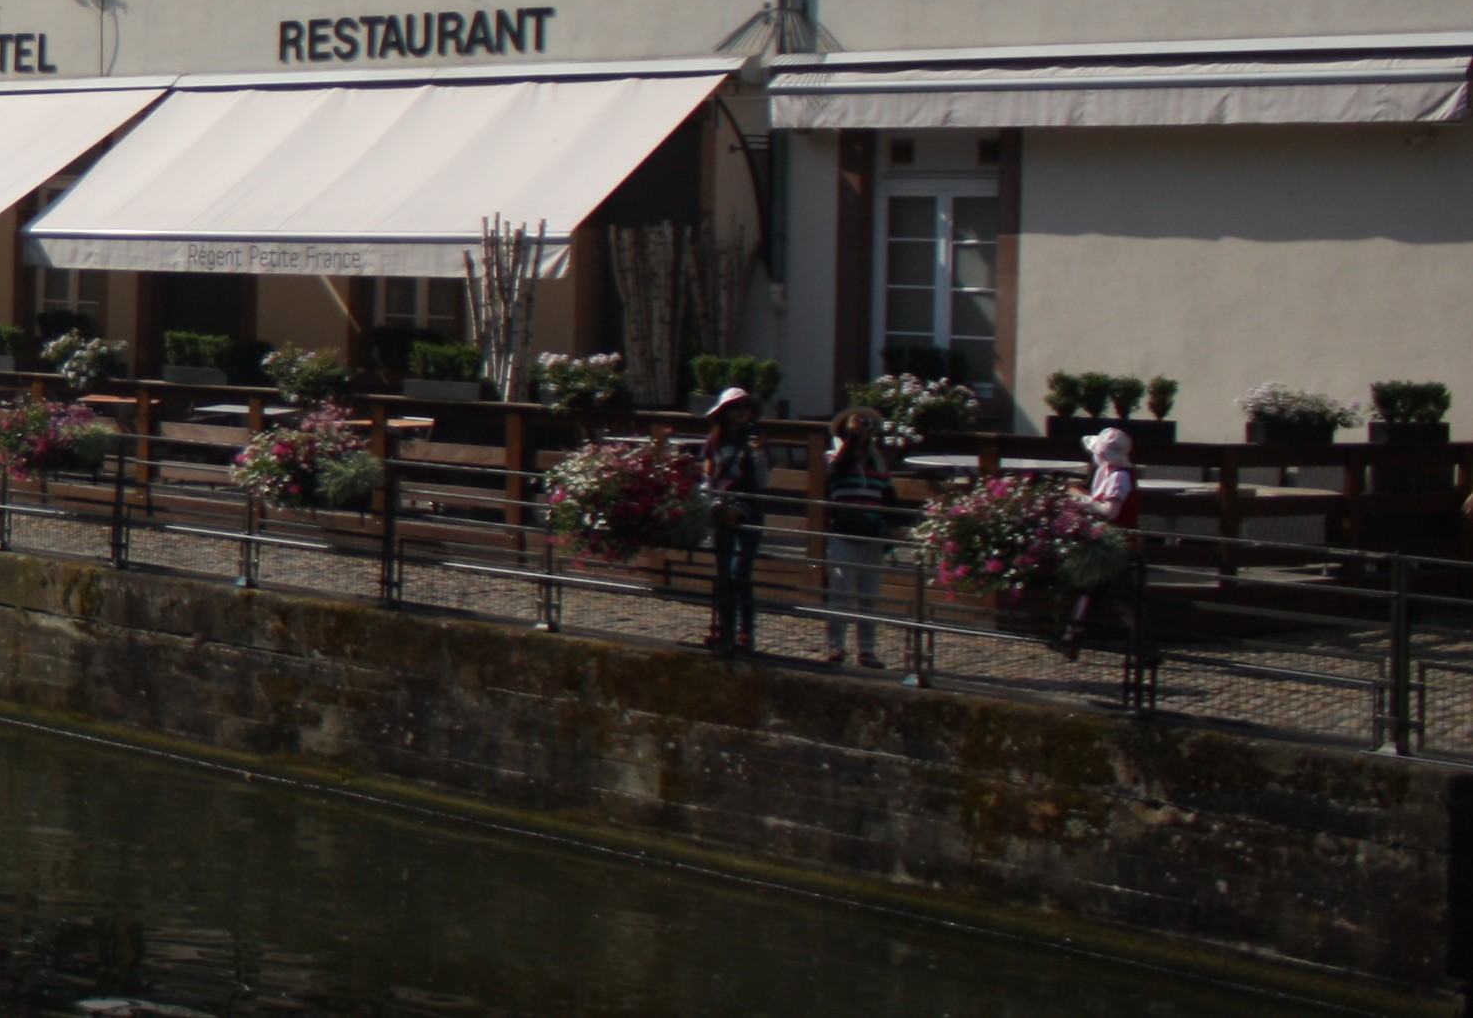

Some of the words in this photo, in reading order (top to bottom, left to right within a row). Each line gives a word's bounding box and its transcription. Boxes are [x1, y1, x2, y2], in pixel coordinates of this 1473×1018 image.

[279, 7, 555, 62] RESTAURANT
[188, 243, 242, 270] Régent
[249, 244, 300, 269] Petite
[305, 246, 362, 270] France
